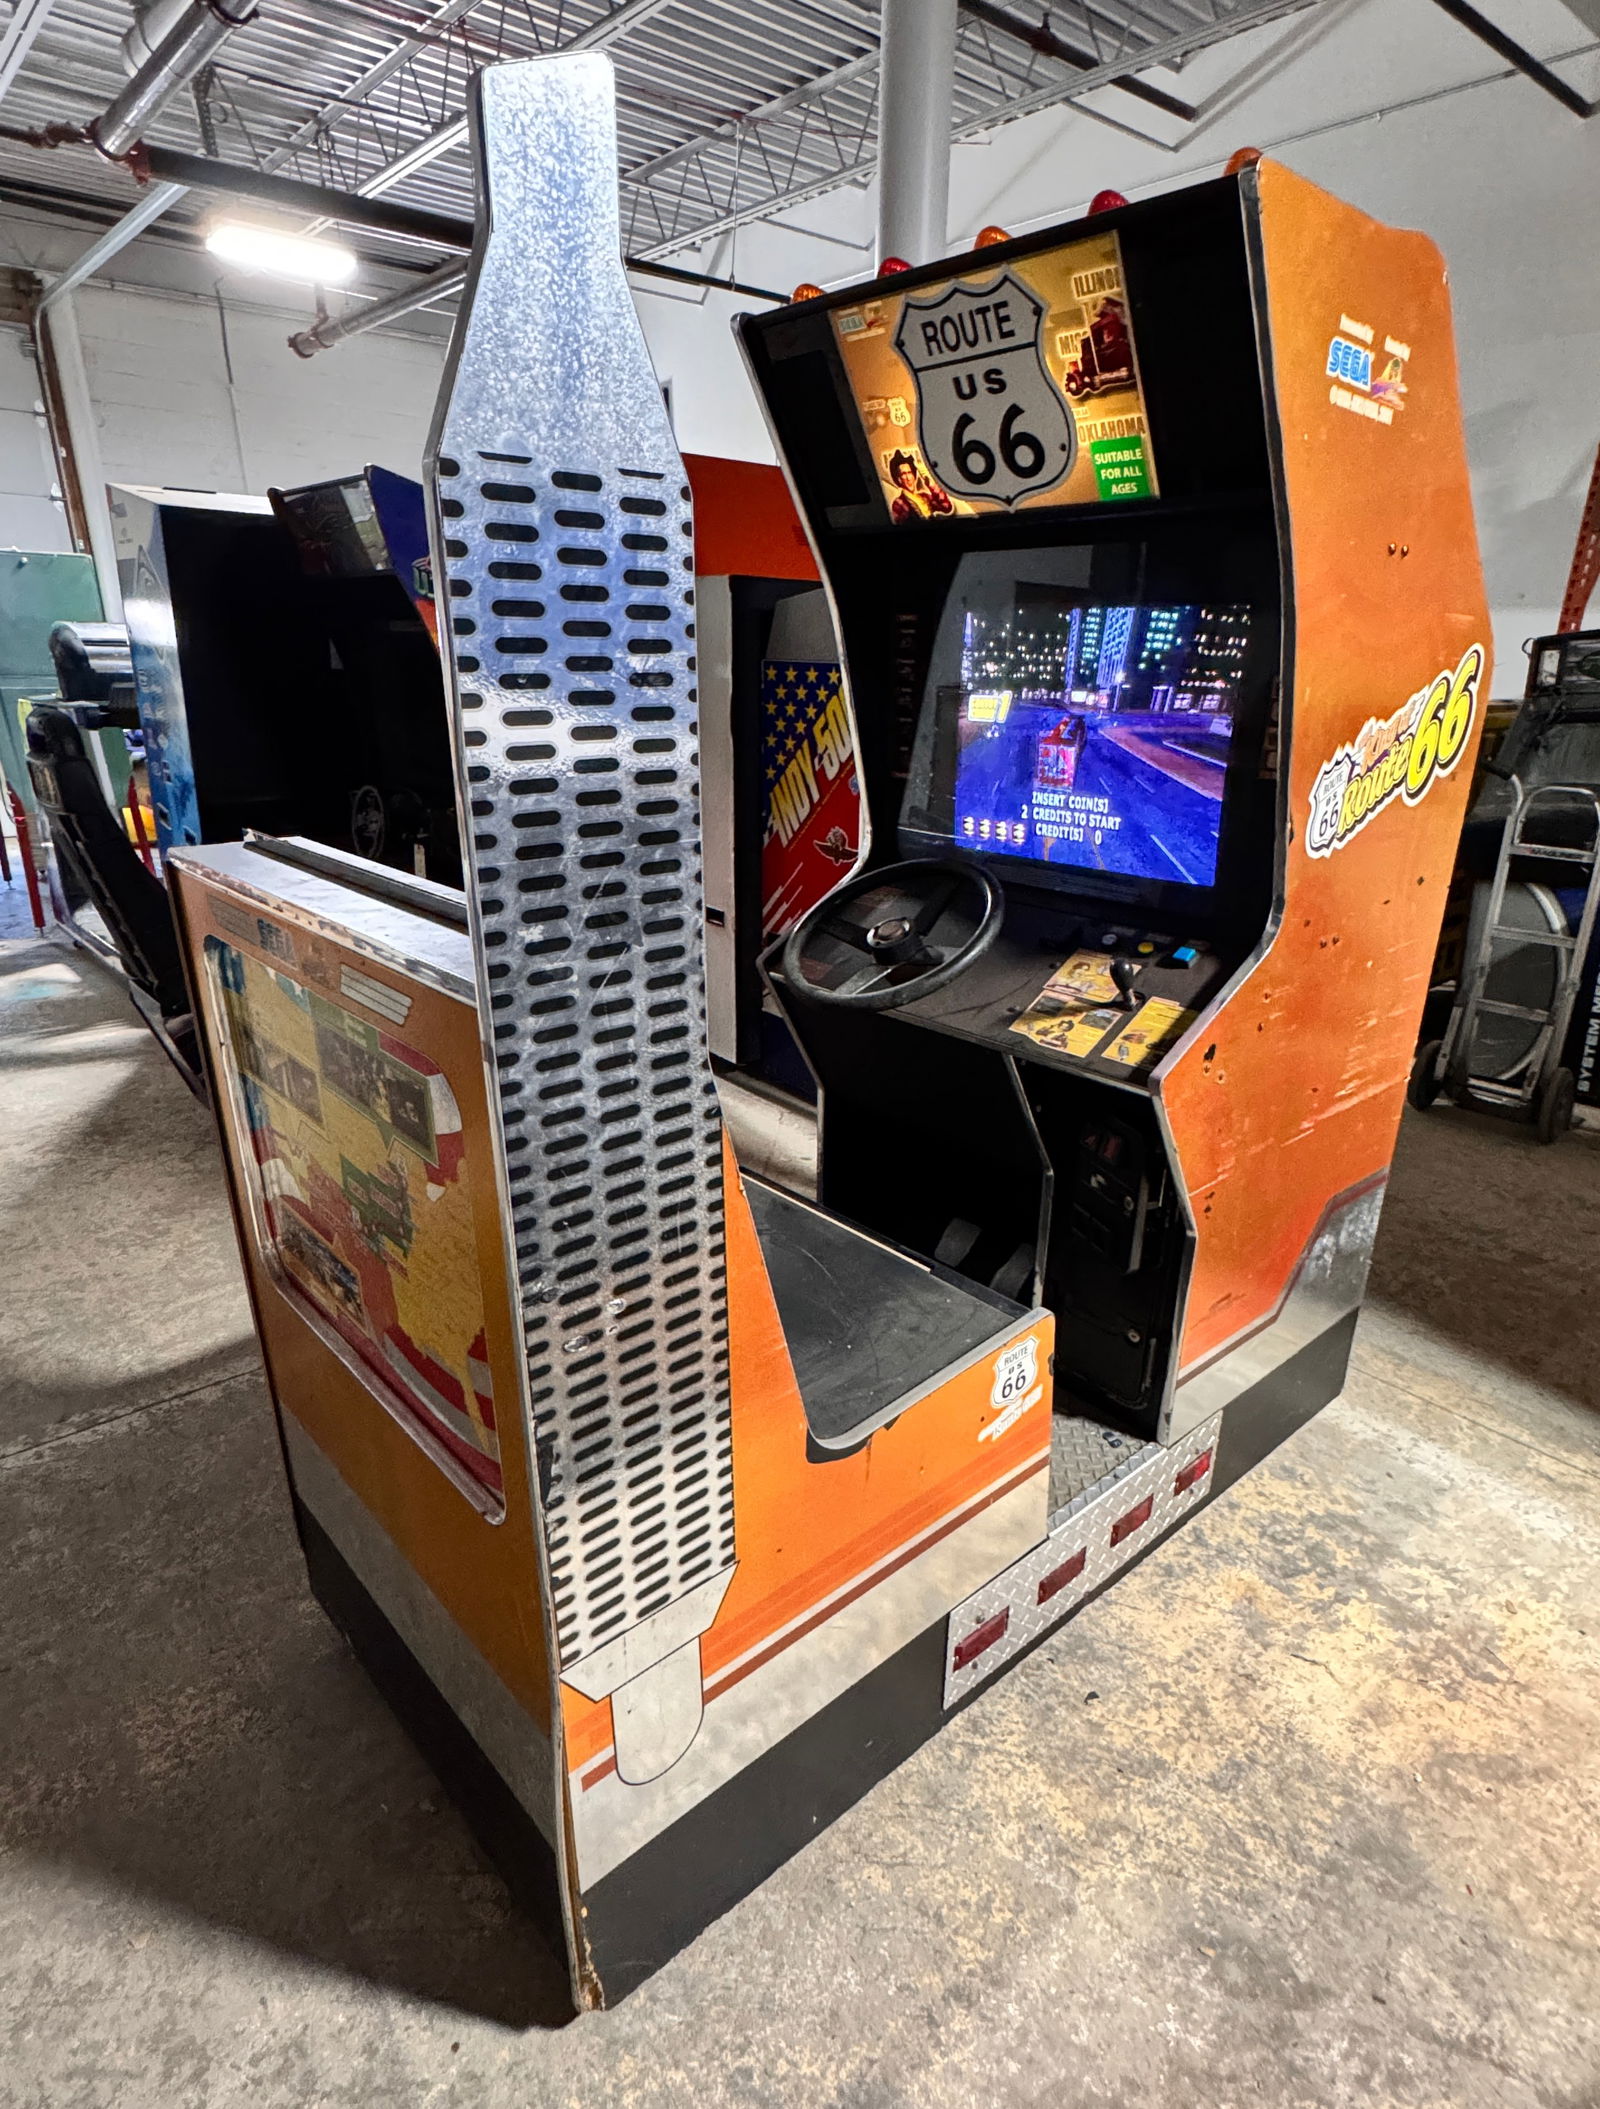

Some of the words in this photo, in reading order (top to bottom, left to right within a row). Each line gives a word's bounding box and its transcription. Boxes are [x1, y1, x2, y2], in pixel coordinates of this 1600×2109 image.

[1073, 268, 1120, 298] ILLINOI
[920, 300, 1016, 356] ROUTE
[1328, 340, 1370, 386] SEGA
[894, 411, 906, 422] 66
[1077, 415, 1147, 444] OKLAHOMA
[952, 403, 1045, 485] 66
[1095, 448, 1143, 465] SUITABLE
[1101, 467, 1122, 480] FOR
[1123, 465, 1143, 478] ALL
[1111, 482, 1138, 496] AGES
[1335, 733, 1414, 840] Route
[1404, 649, 1481, 800] 66
[1323, 770, 1344, 794] ROUTE
[1032, 791, 1066, 807] INSERT
[1021, 804, 1028, 819] 2
[1033, 806, 1072, 825] CREDITS
[1073, 811, 1087, 826] TO
[1088, 815, 1122, 830] START
[1318, 801, 1339, 838] 66
[1095, 831, 1102, 845] 0
[1004, 1345, 1029, 1366] ROUTE
[1002, 1369, 1026, 1399] 66
